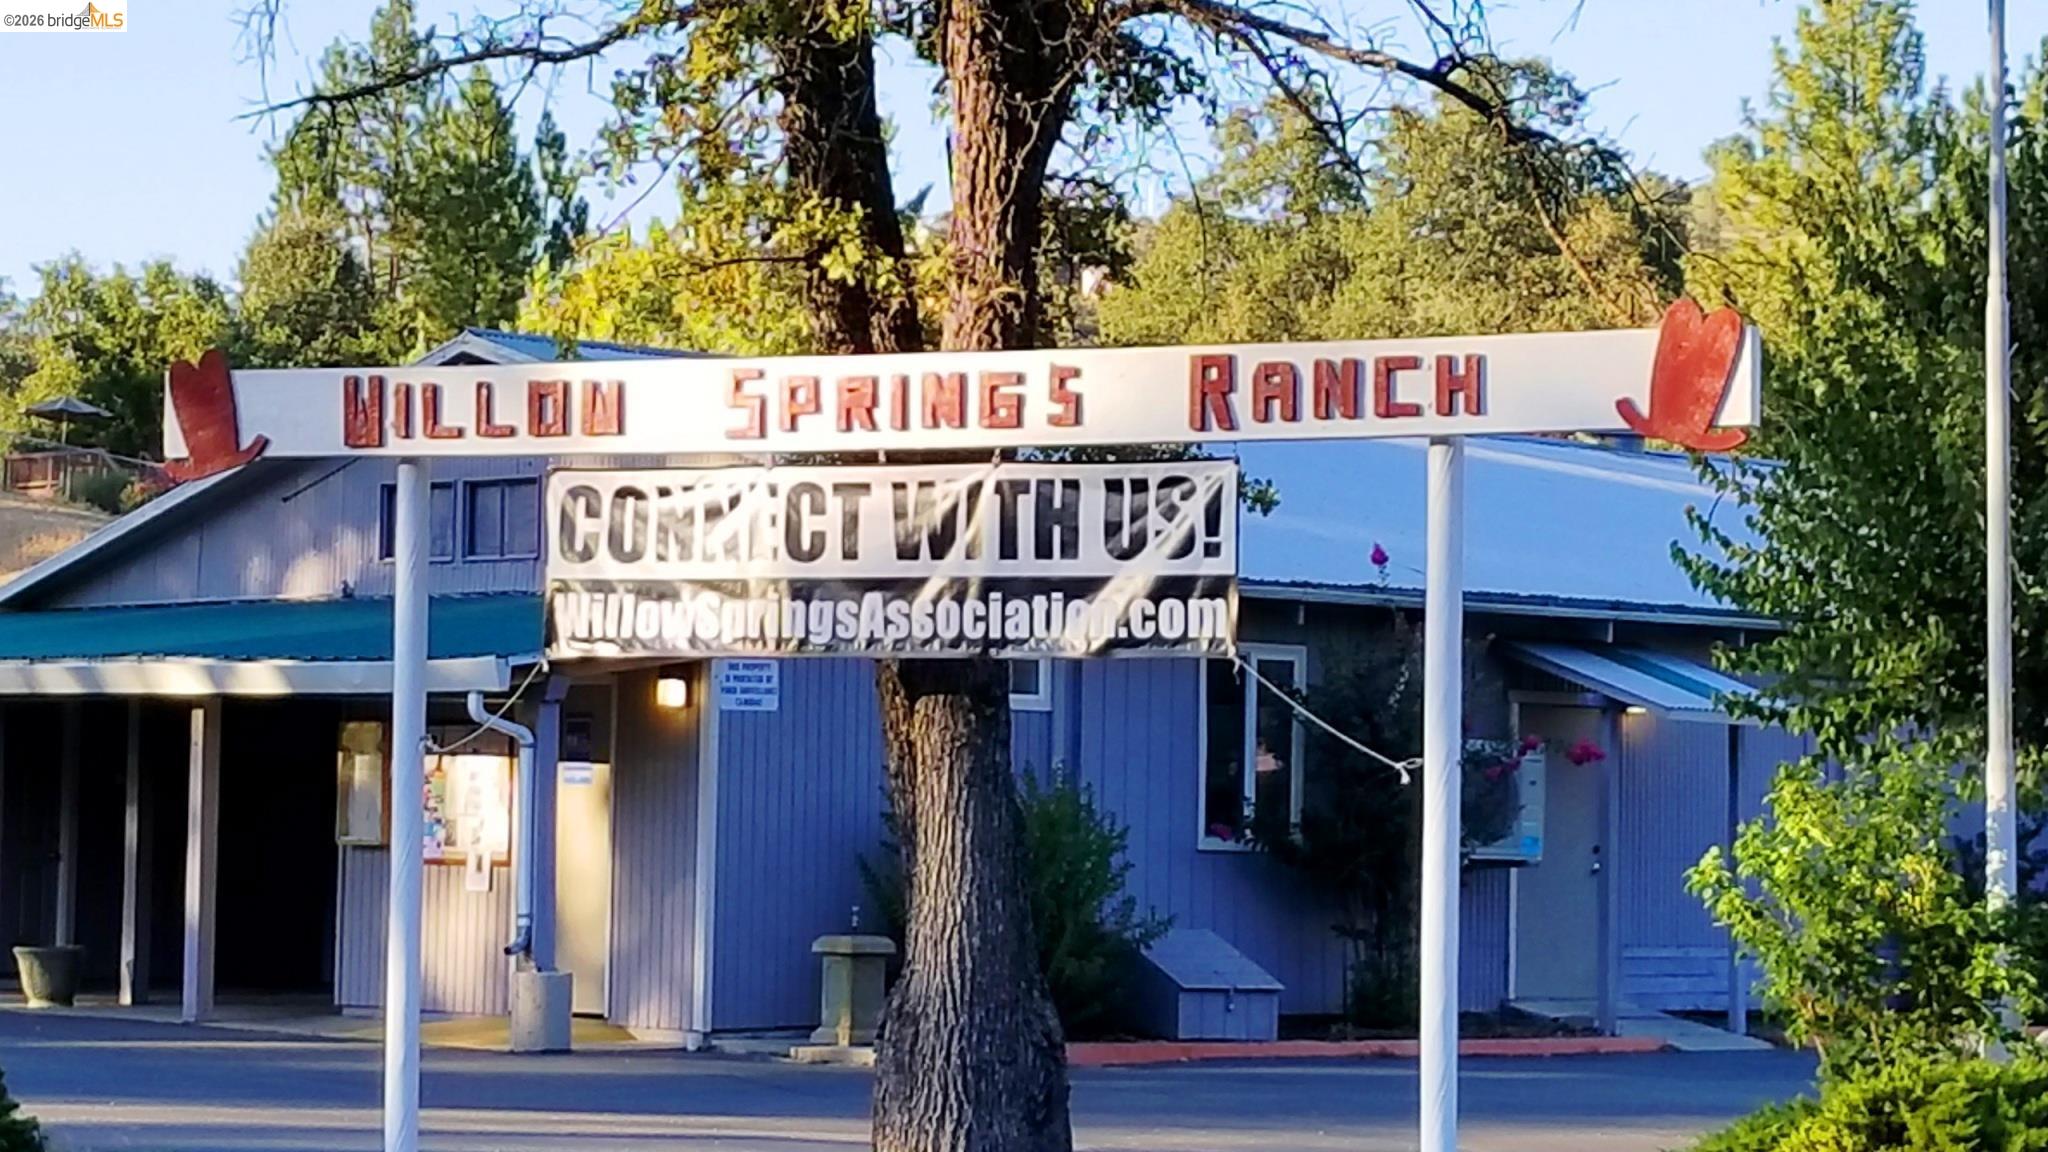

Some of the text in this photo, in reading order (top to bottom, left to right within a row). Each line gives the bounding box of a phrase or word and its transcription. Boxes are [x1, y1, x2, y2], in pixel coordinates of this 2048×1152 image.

[344, 354, 1486, 448] WILLOW SPRINGS RANCH
[891, 477, 1081, 561] WITH
[1103, 474, 1223, 561] US!
[552, 590, 1228, 649] WillowSpringsAssociation.com
